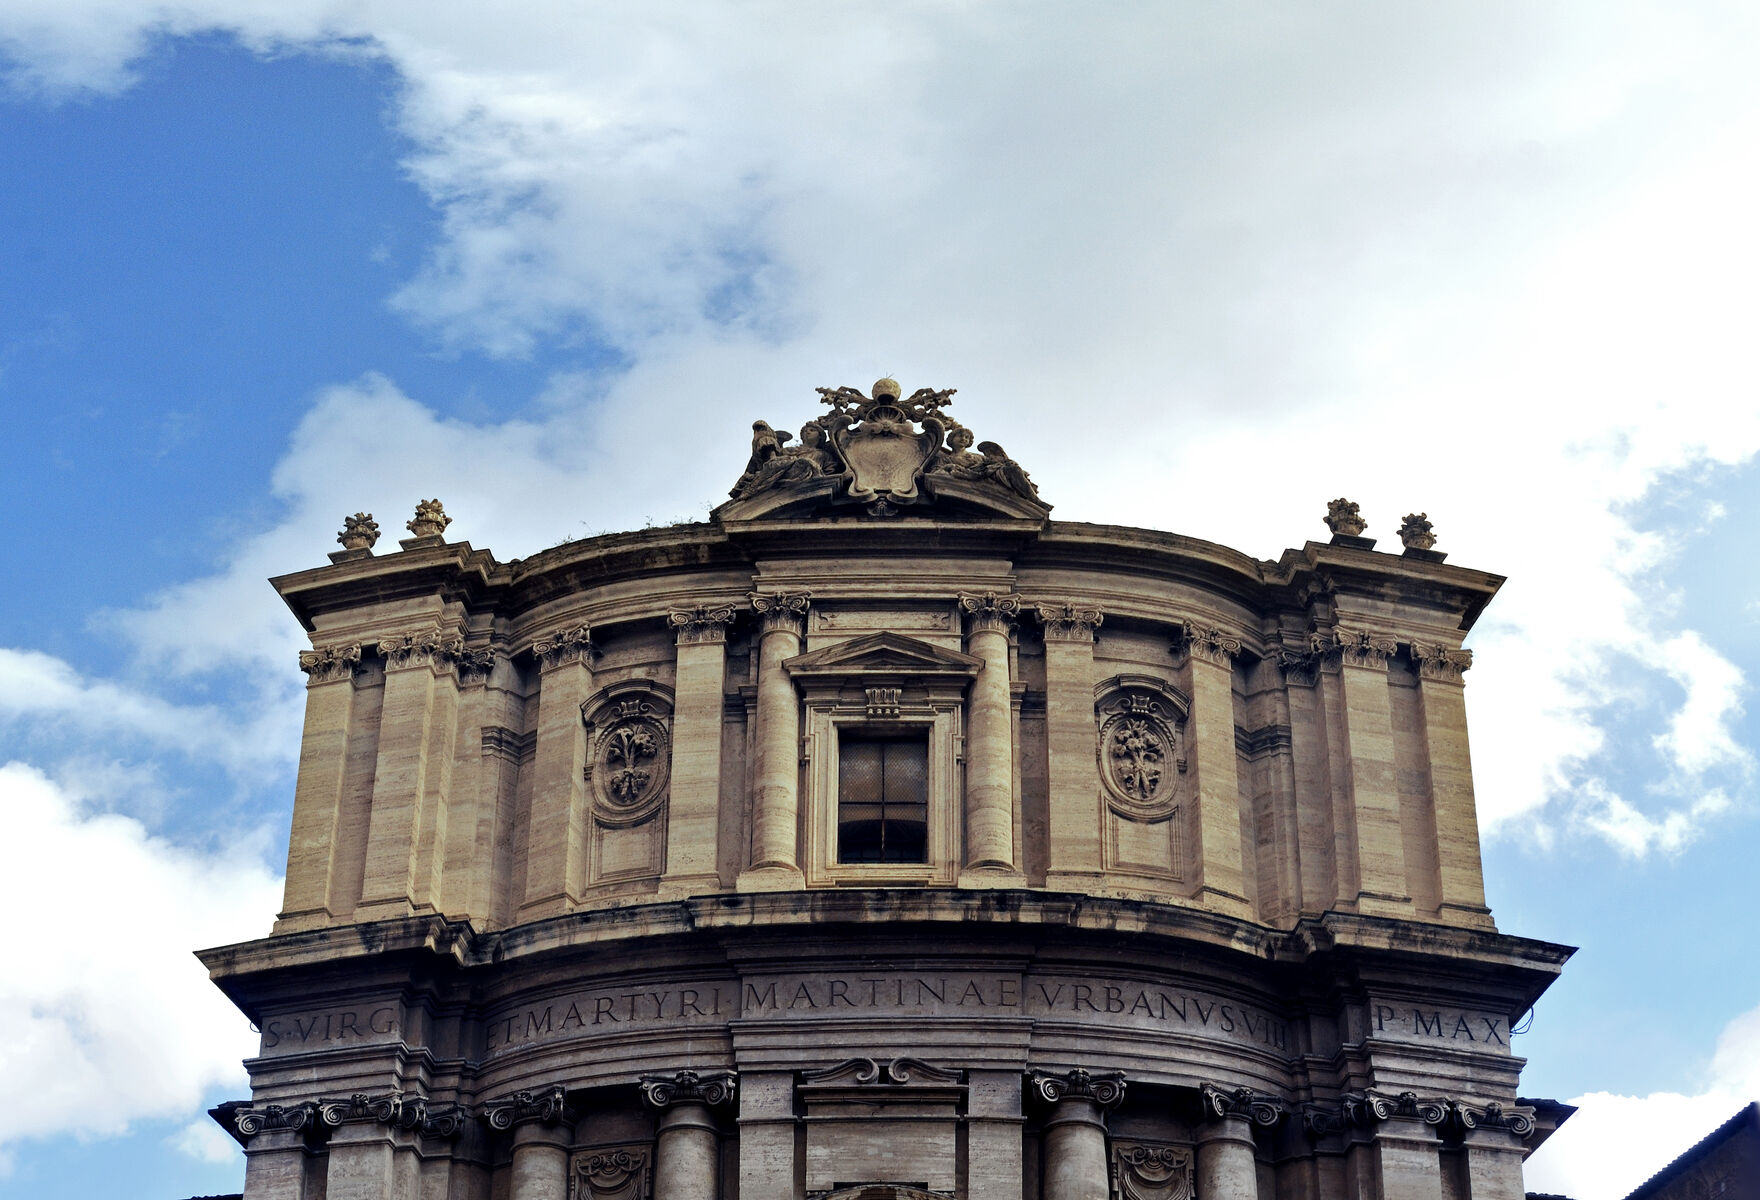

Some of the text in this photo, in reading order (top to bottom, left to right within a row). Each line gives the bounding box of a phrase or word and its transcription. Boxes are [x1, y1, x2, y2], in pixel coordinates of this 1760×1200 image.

[486, 1014, 520, 1051] ET
[523, 988, 721, 1038] MARTYRI
[744, 979, 1018, 1011] MARTINAE
[1036, 983, 1235, 1033] VRBANVS
[1413, 1008, 1508, 1046] MAX
